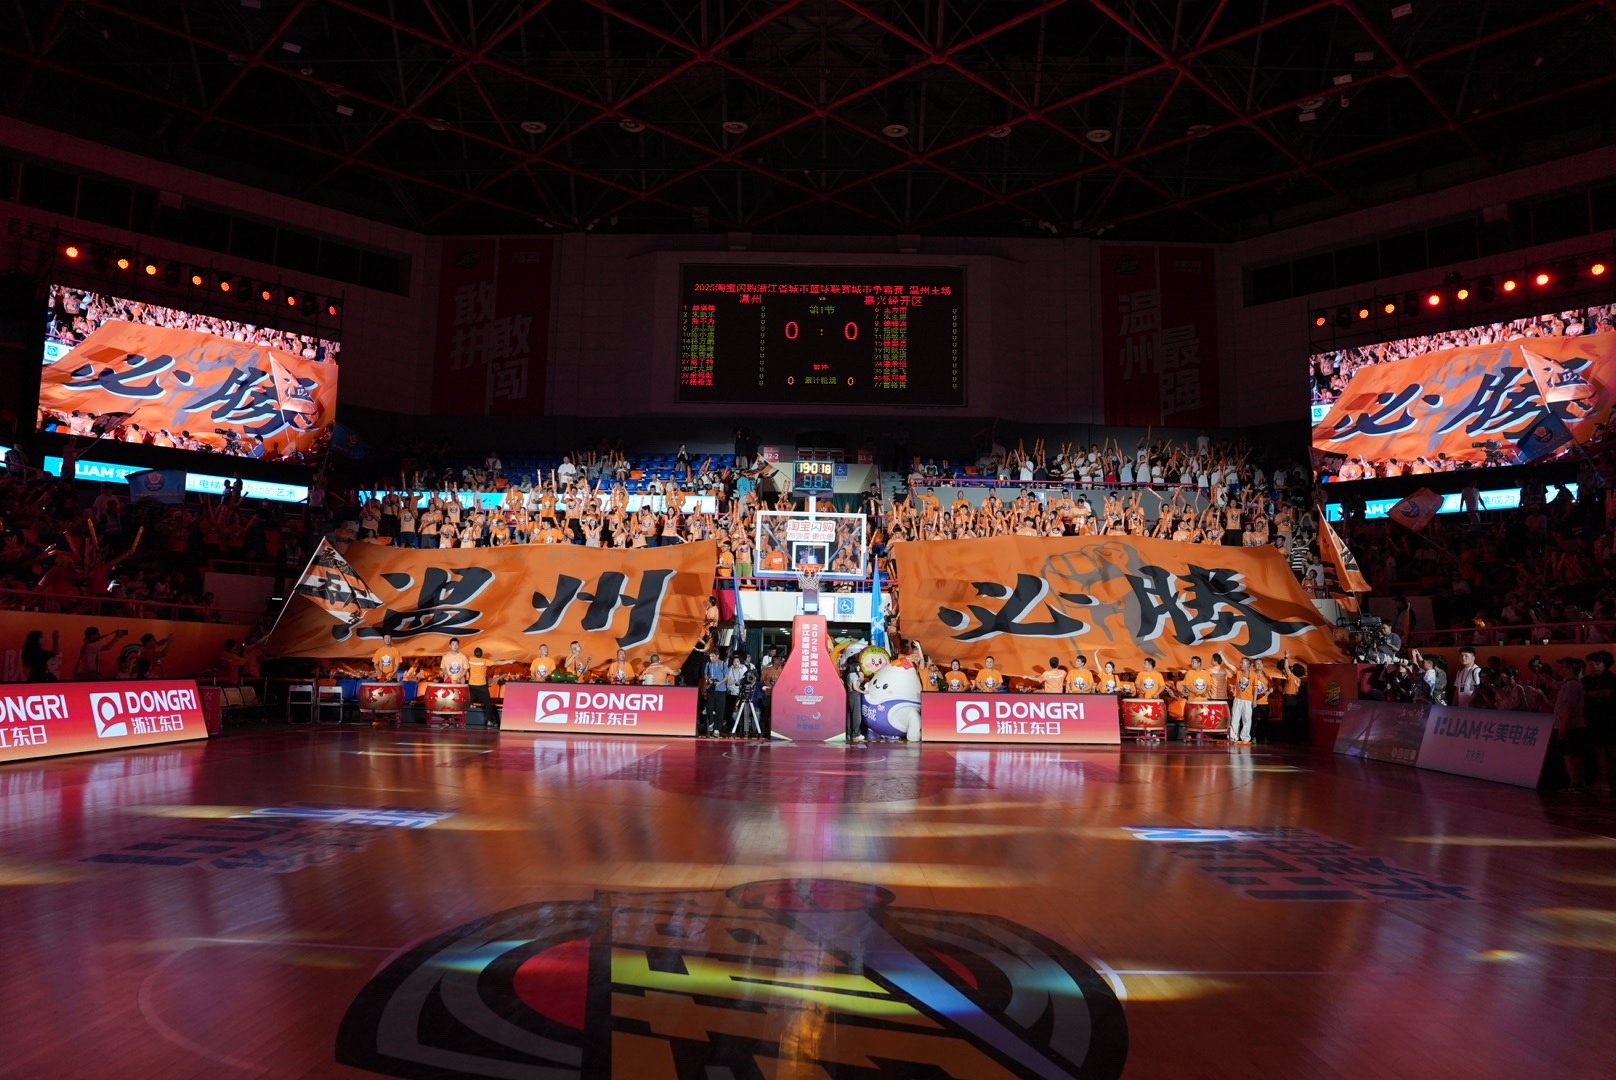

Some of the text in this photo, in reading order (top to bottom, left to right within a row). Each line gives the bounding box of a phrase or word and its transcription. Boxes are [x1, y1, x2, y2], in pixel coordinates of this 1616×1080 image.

[785, 321, 799, 339] 0
[844, 322, 858, 340] 0
[787, 376, 795, 385] 0
[847, 377, 855, 386] 0
[789, 521, 834, 532] 淘宝闪购
[124, 689, 197, 715] DONGRI
[575, 692, 664, 712] DONGRI
[995, 702, 1085, 720] DONGRI
[130, 714, 184, 735] 浙江东日
[574, 711, 638, 727] 浙江东日
[996, 721, 1061, 735] 浙江东日
